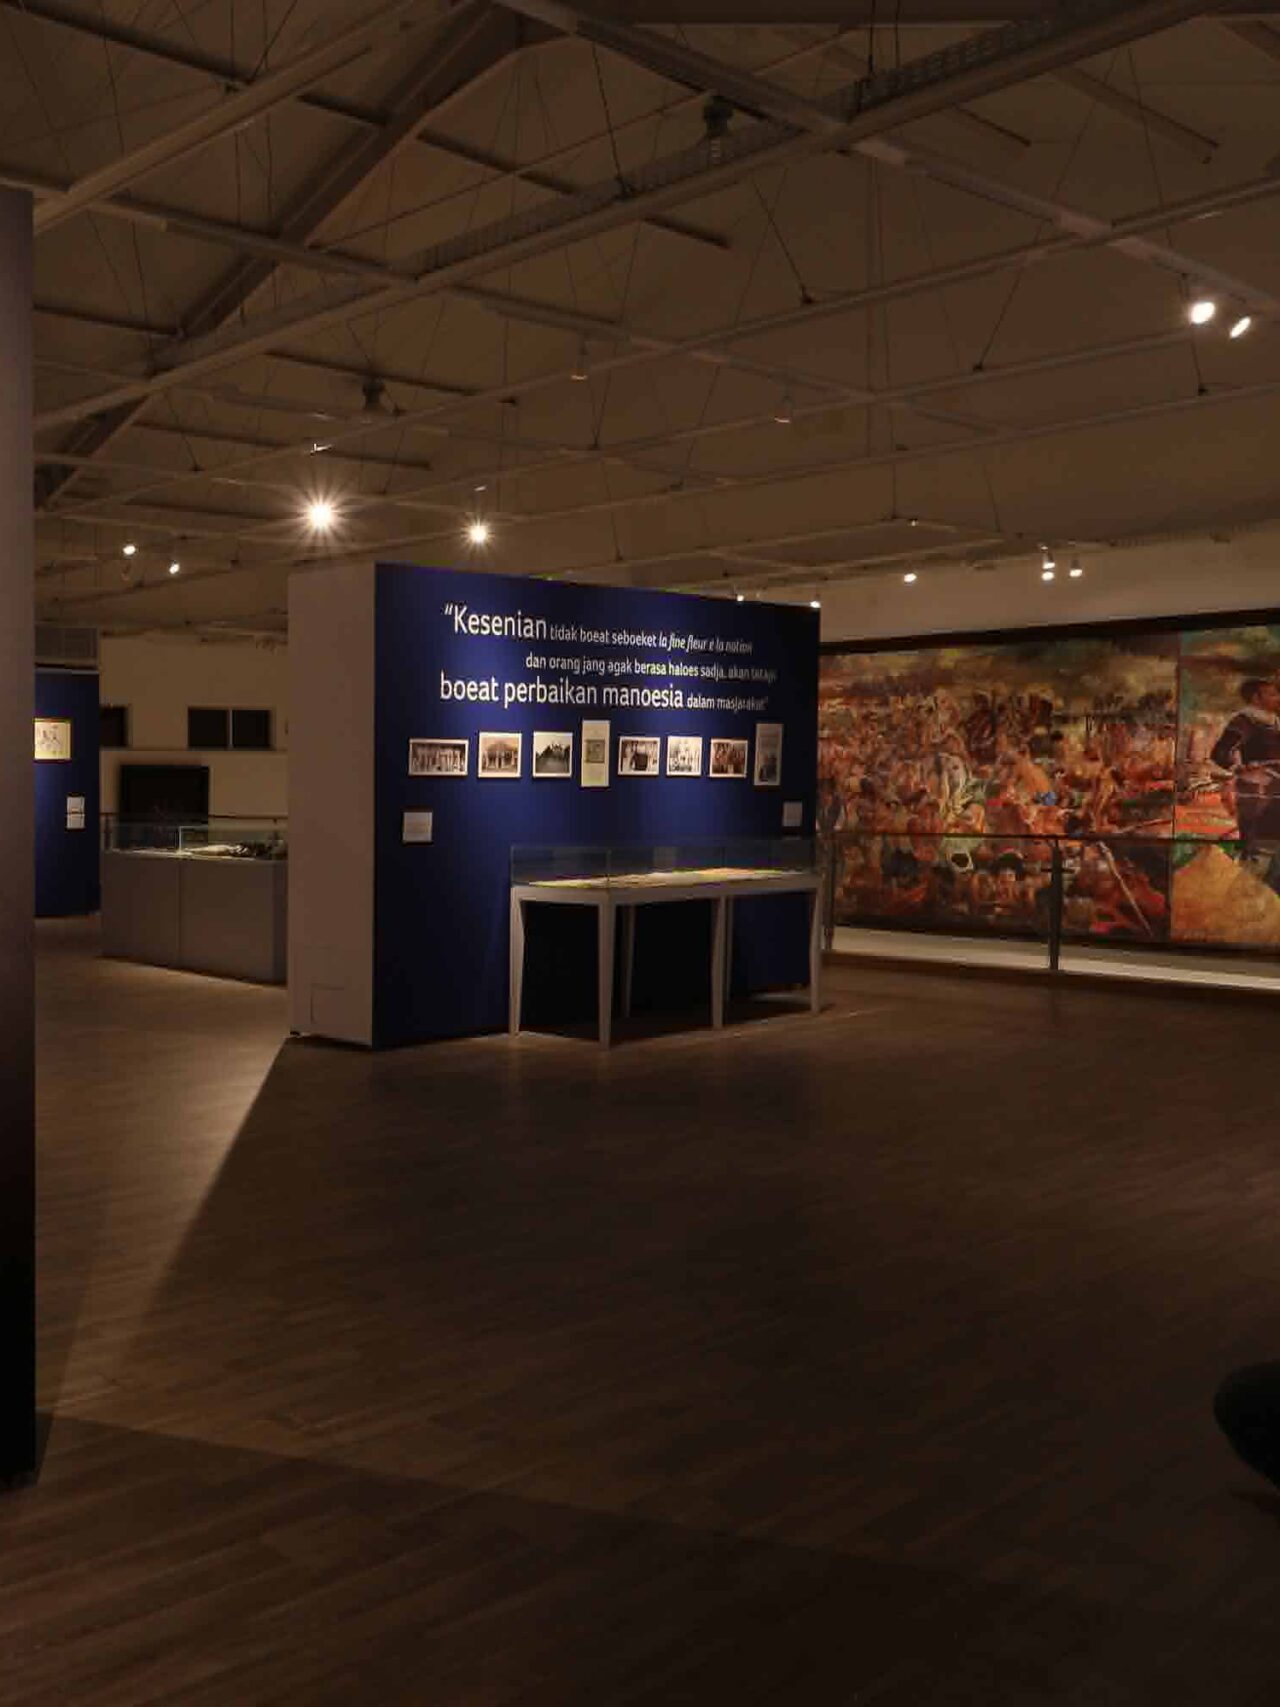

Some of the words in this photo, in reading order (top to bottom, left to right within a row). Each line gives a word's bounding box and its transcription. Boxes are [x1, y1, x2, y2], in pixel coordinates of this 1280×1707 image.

[550, 624, 577, 641] tidak
[580, 627, 610, 643] boeat
[612, 629, 658, 647] seboeket
[659, 631, 667, 647] la
[525, 651, 547, 669] dan
[549, 657, 580, 674] orang
[582, 656, 605, 676] jang
[607, 657, 632, 676] agak
[634, 658, 666, 675] berasa
[668, 659, 699, 677] haloes
[440, 670, 499, 701] boeat
[504, 675, 597, 709] perbaikan
[602, 684, 684, 708] manoesia
[686, 691, 715, 710] dalam
